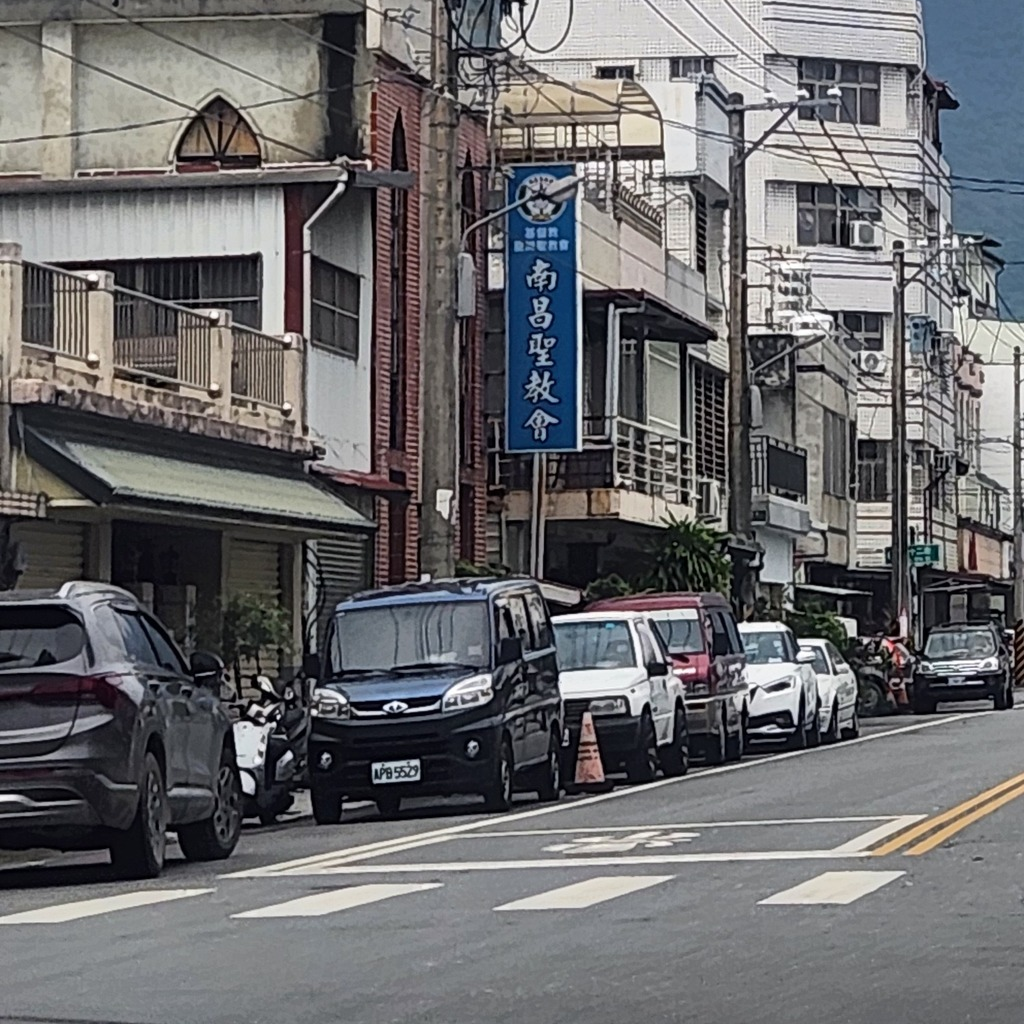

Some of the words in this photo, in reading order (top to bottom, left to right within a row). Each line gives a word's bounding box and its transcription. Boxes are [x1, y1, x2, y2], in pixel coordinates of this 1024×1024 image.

[524, 258, 560, 442] 南昌聖教會
